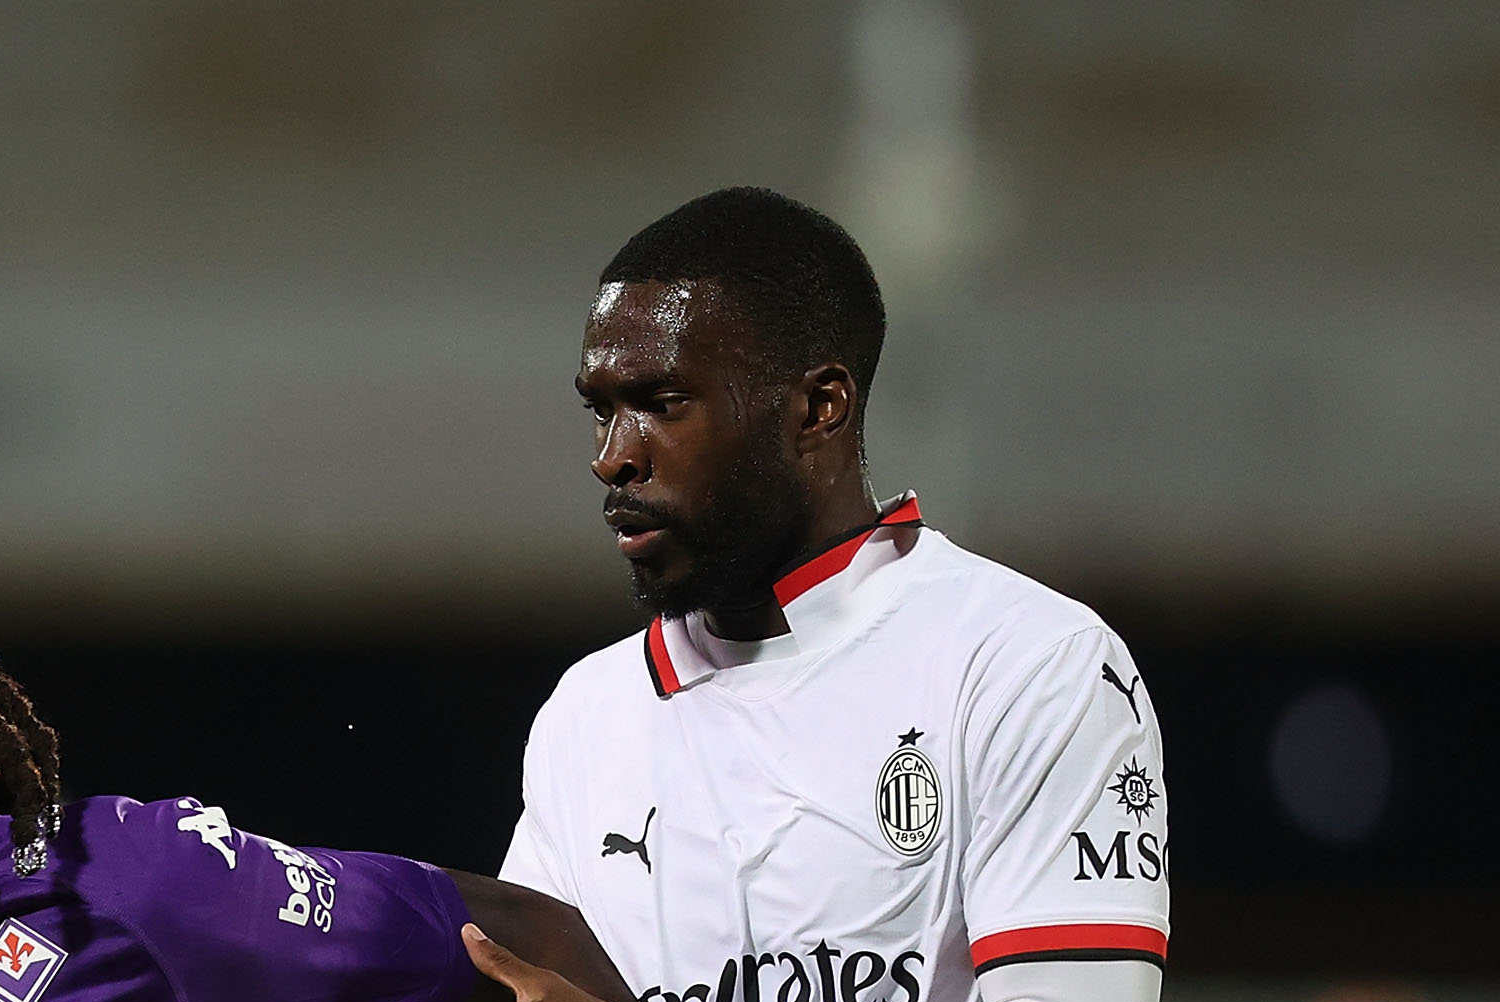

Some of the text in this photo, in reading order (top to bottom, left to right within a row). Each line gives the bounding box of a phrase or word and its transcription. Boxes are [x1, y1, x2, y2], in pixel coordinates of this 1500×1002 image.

[891, 757, 926, 777] ACM
[894, 831, 925, 842] 1899
[1071, 830, 1169, 882] MS
